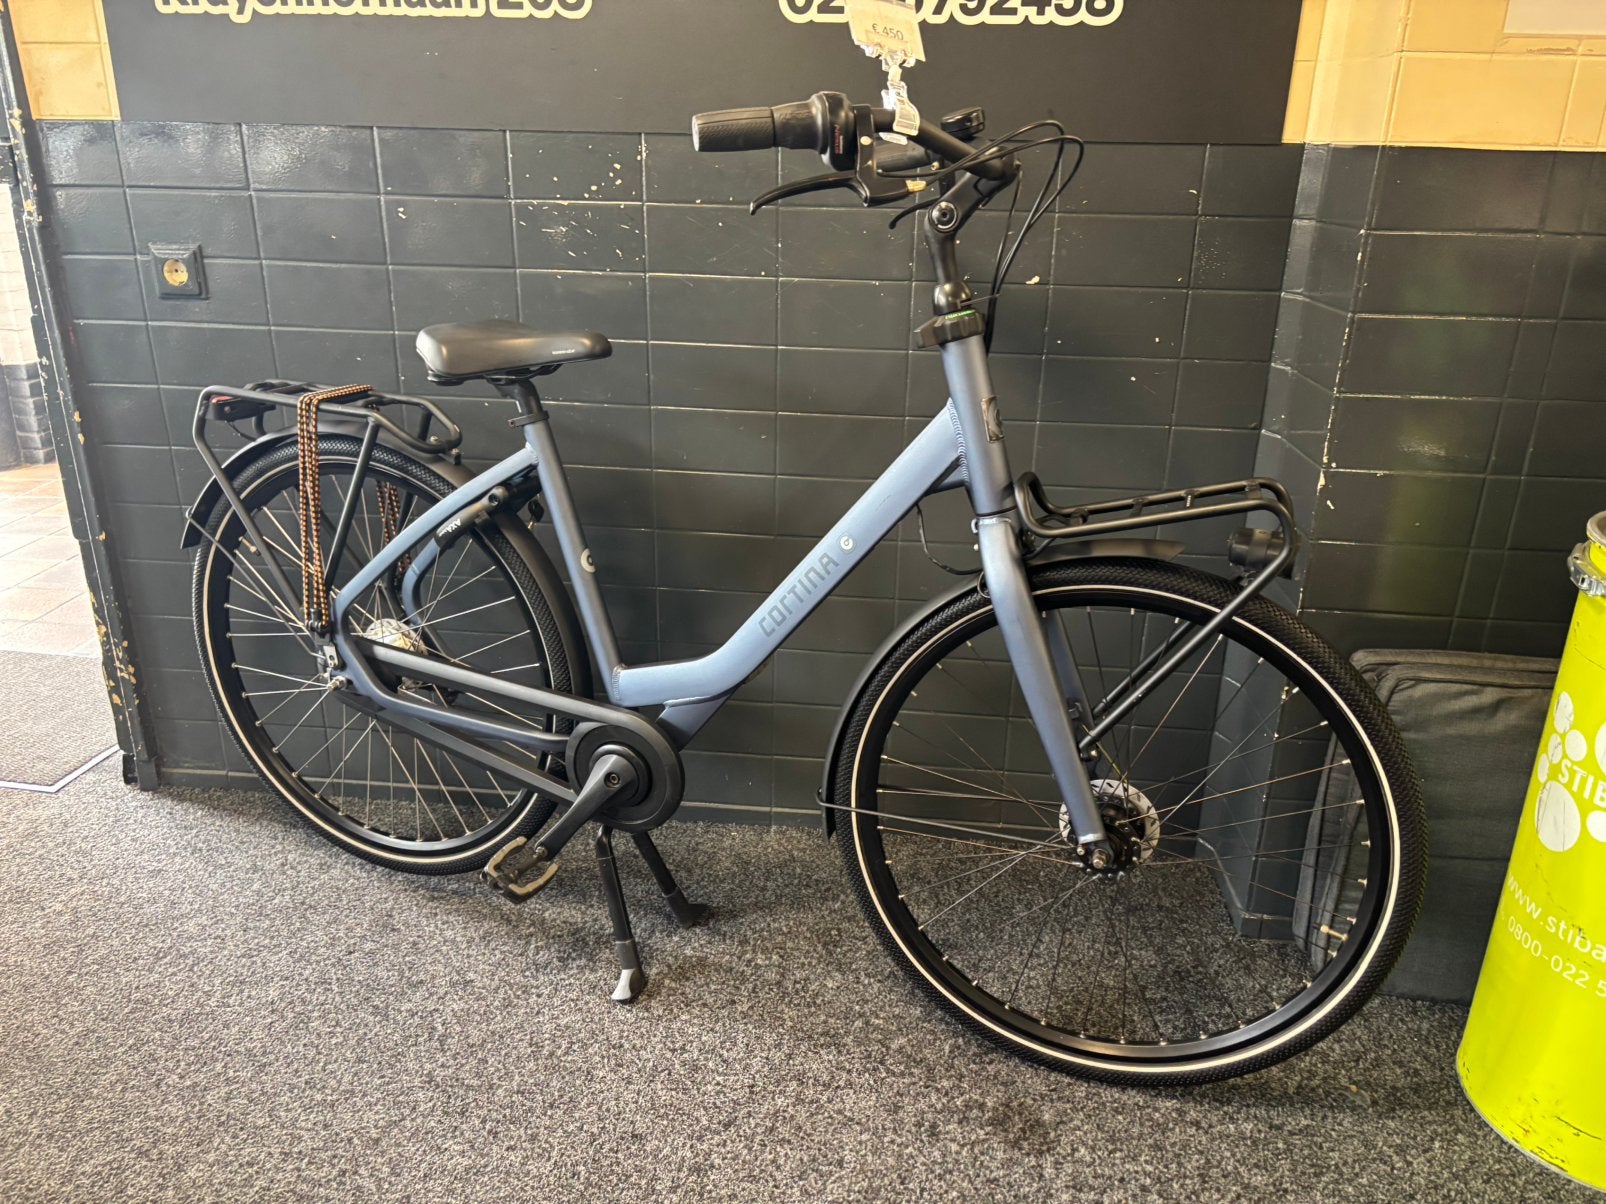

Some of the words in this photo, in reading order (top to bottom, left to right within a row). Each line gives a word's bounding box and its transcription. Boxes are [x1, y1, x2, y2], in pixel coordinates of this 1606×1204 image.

[882, 26, 904, 41] 450
[758, 552, 840, 638] CORTINA
[1507, 915, 1587, 989] 0800-022
